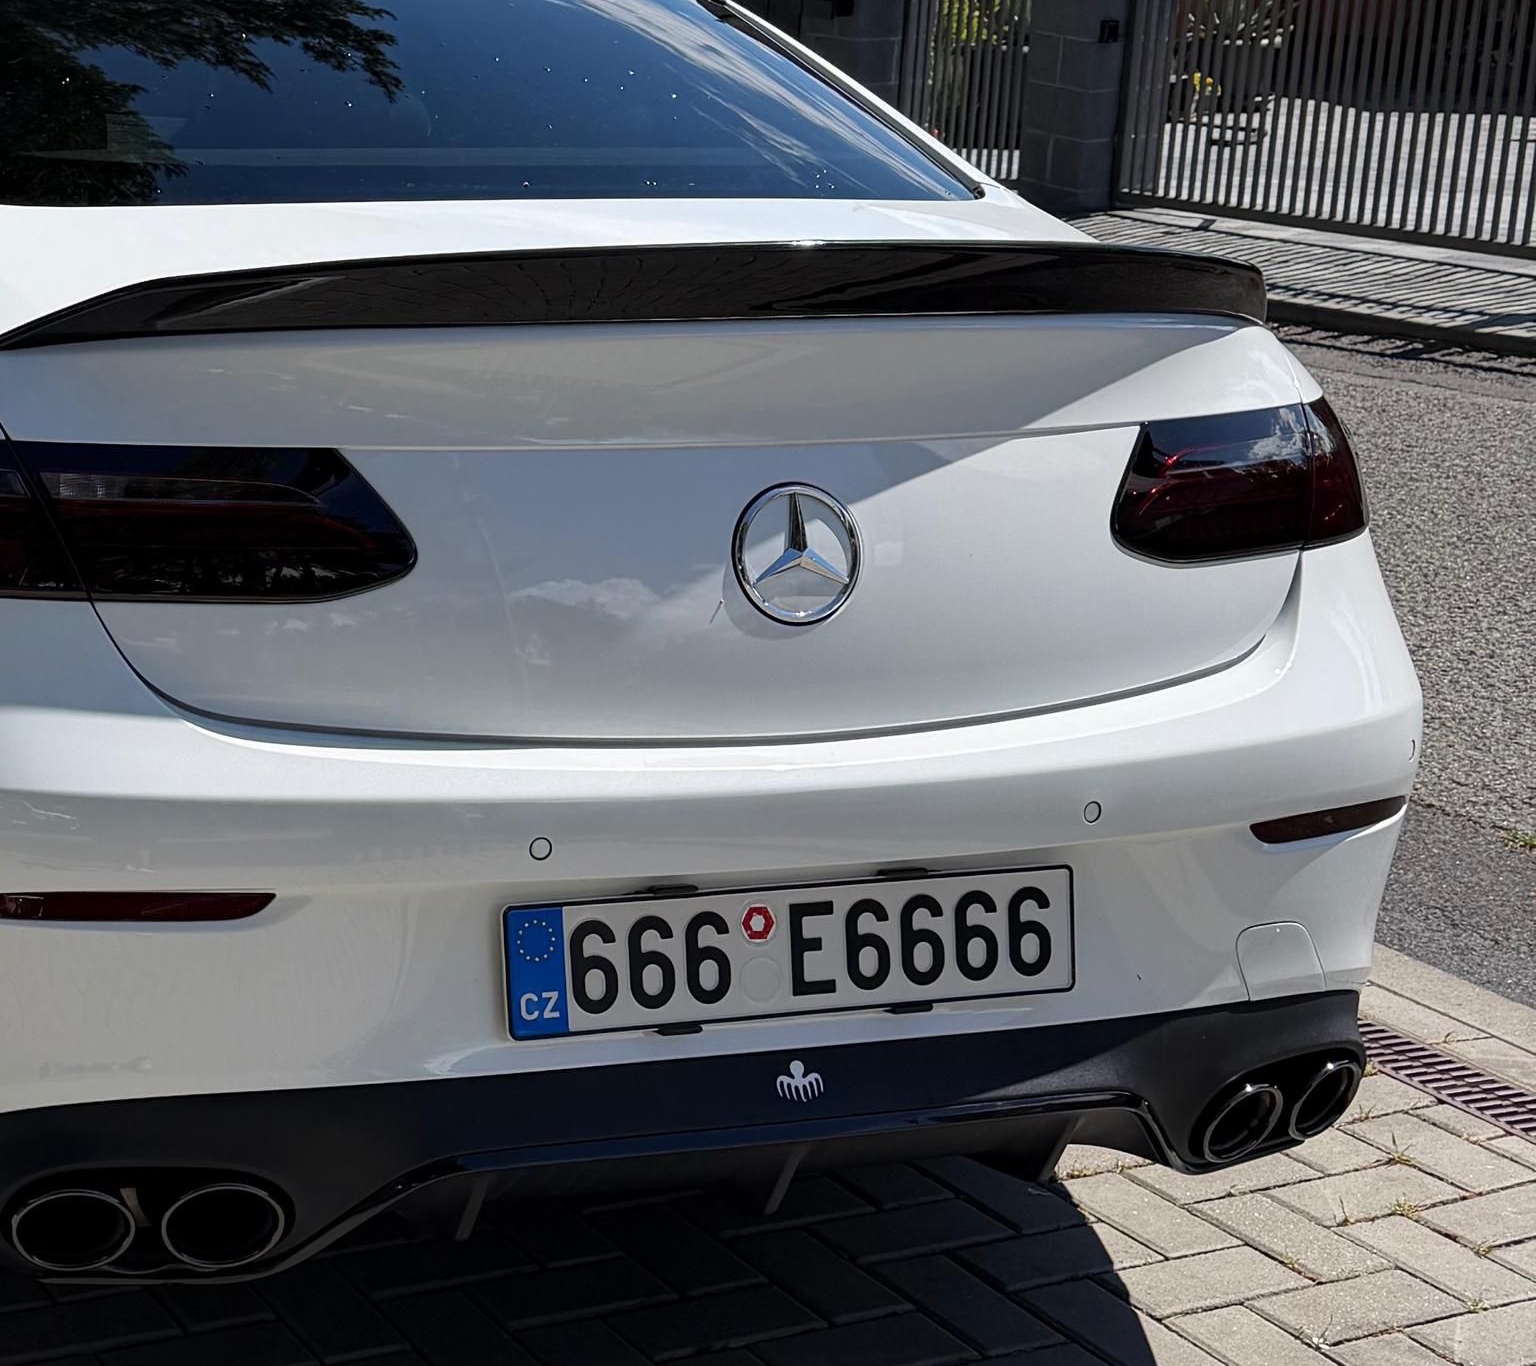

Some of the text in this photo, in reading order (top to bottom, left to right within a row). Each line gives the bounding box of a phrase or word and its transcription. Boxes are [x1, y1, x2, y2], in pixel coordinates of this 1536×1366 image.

[569, 886, 1052, 1015] 666 E6666
[519, 991, 560, 1020] CZ
